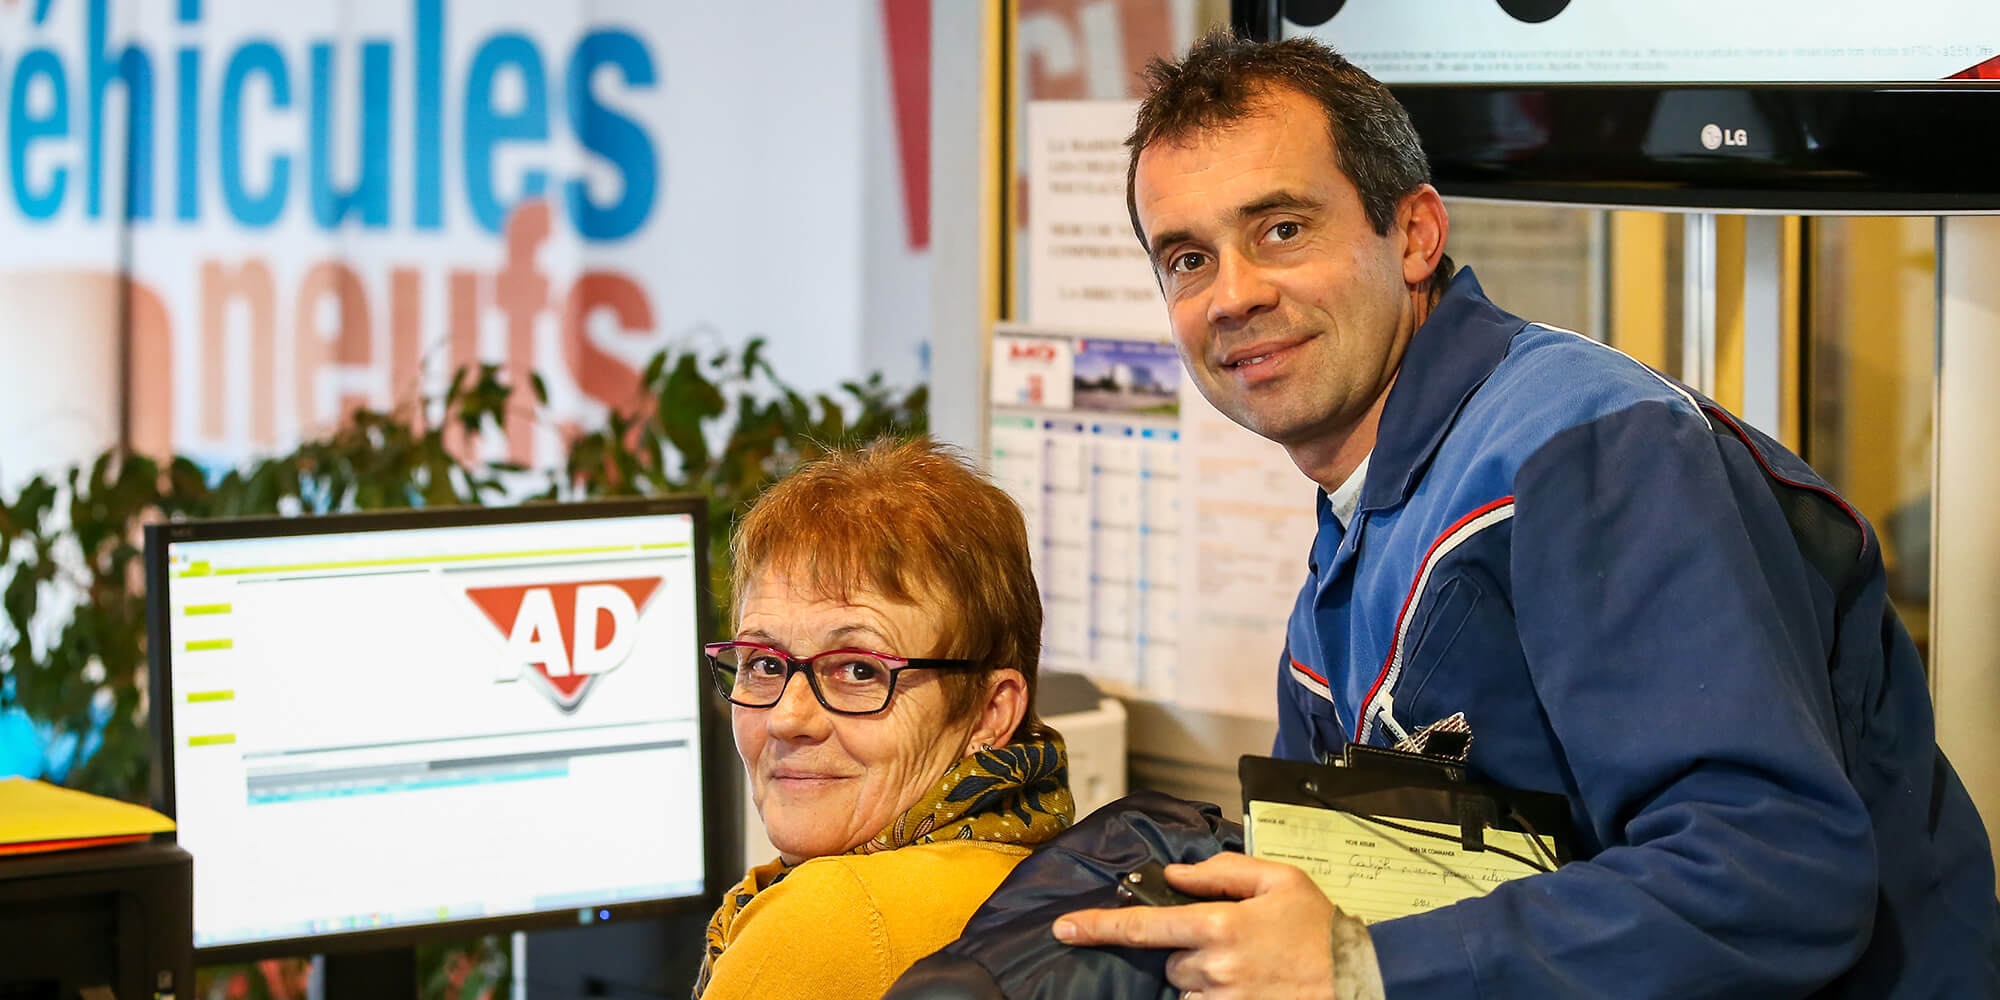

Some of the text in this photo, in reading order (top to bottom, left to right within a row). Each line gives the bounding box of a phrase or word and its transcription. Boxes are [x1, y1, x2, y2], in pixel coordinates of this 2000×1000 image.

[0, 0, 660, 242] éhicules
[1724, 129, 1748, 146] LG
[198, 195, 656, 472] neufs
[494, 584, 638, 683] AD
